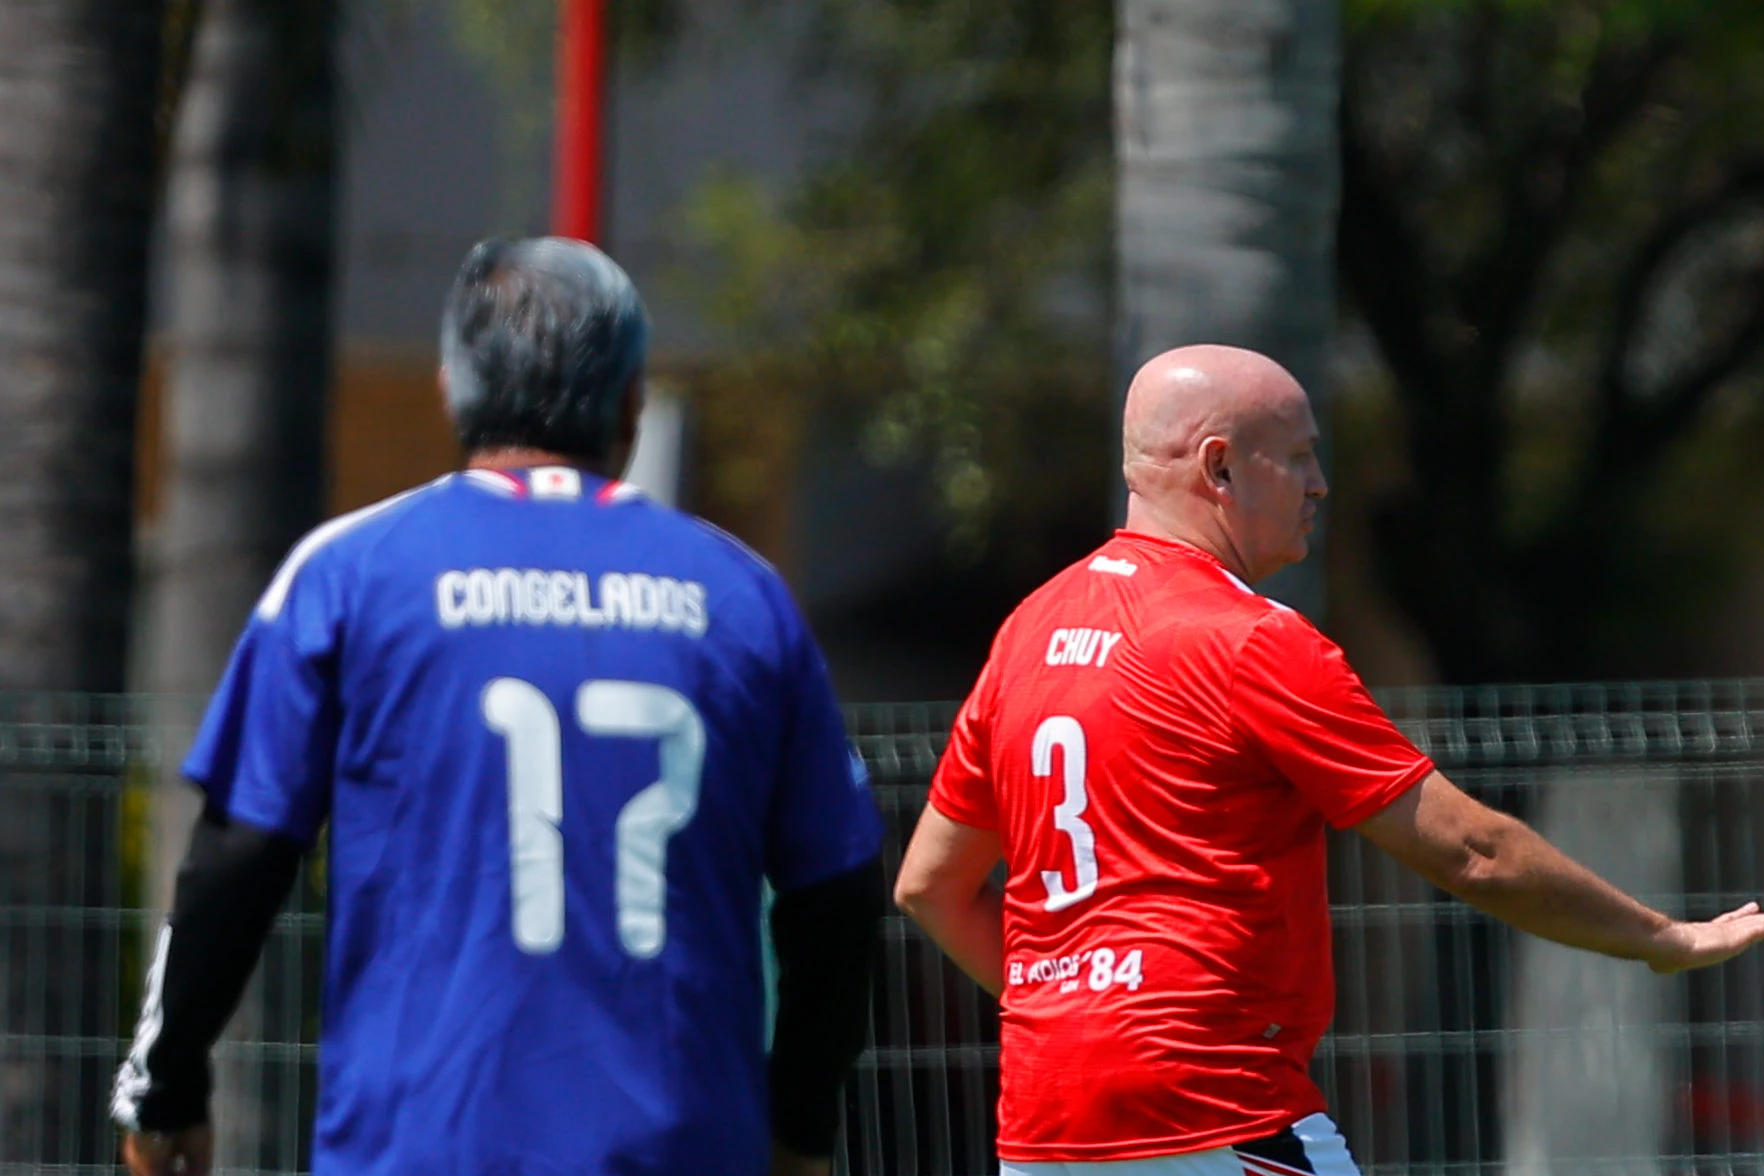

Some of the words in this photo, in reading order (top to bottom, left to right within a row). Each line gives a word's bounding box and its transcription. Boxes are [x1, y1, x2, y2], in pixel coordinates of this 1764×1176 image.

[436, 567, 707, 637] CONGELADOS
[1045, 628, 1121, 668] CHUY
[480, 677, 706, 959] 17
[1031, 715, 1098, 913] 3
